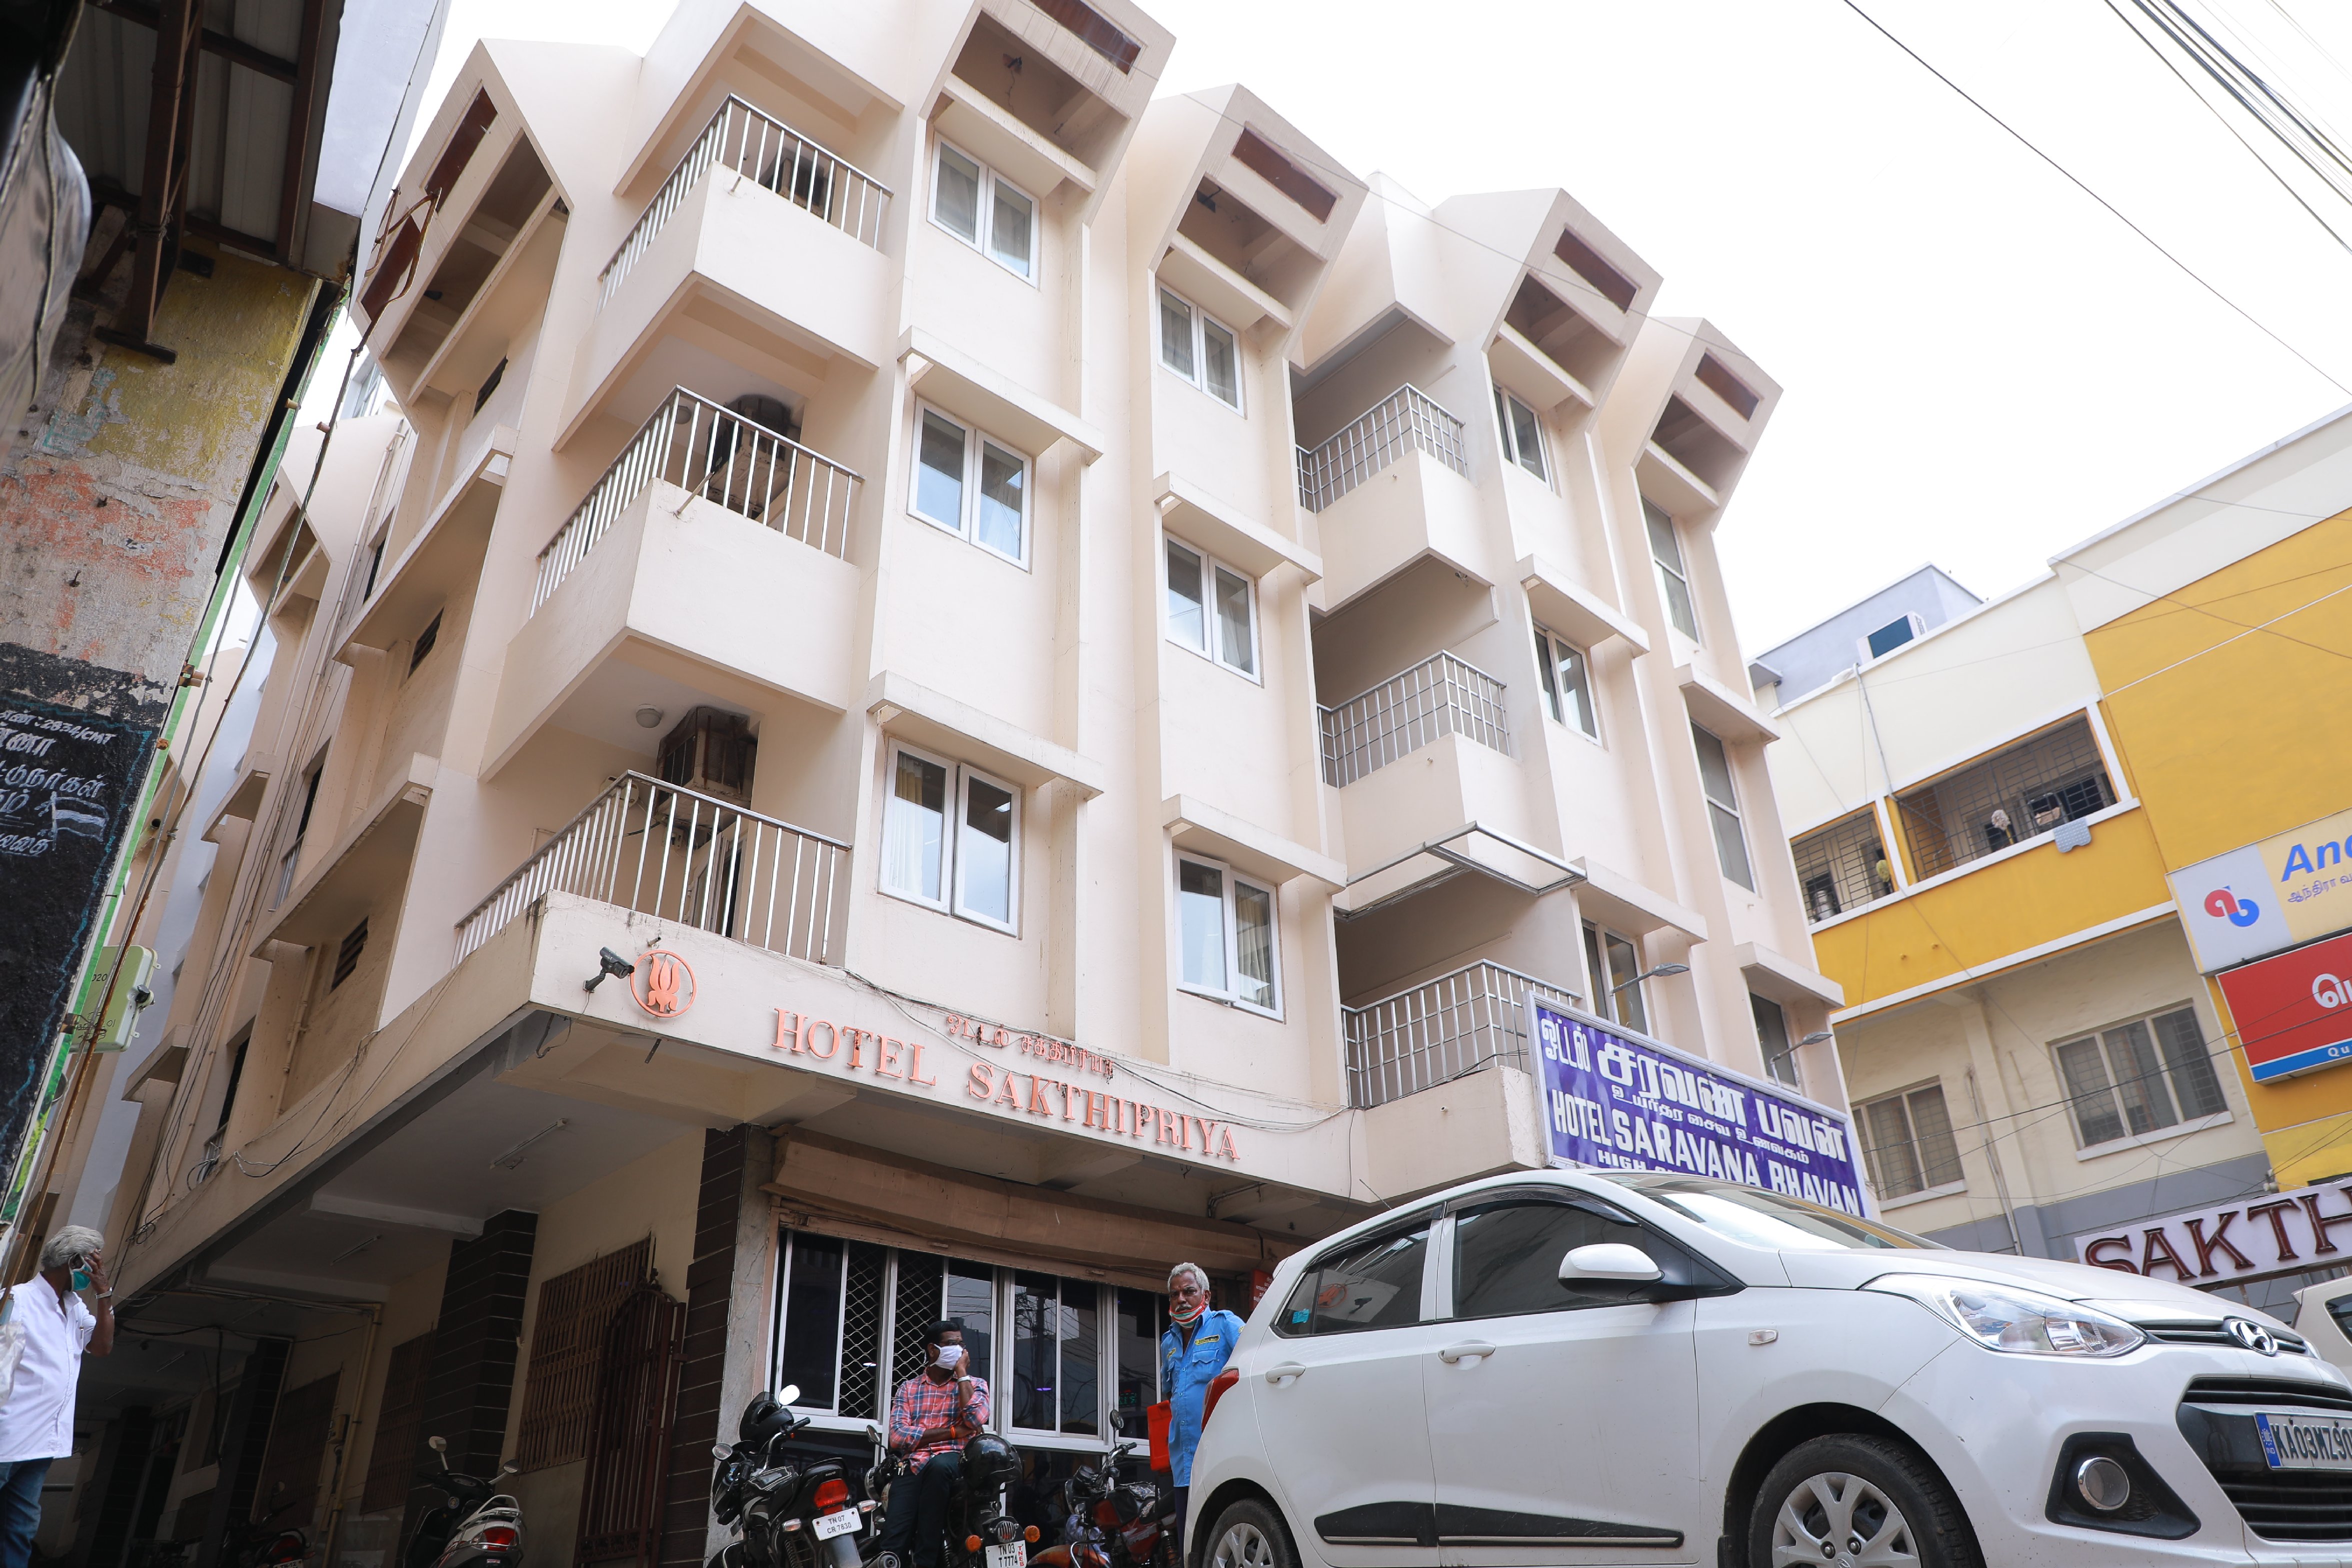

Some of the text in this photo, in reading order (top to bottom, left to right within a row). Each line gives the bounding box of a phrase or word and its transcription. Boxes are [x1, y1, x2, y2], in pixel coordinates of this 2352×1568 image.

[2287, 878, 2336, 902] ஆந்திரா
[2327, 1045, 2352, 1057] Qu
[772, 1008, 1241, 1160] HOTEL SAKTHIPRIYA
[1611, 1084, 1809, 1164] உயர்தர சைவ உணவகம்
[1755, 1098, 1847, 1162] பவன்
[1552, 1088, 1861, 1216] HOTEL SARAVANA BHAVAN
[1597, 1149, 1647, 1170] HIGH
[2269, 1423, 2352, 1460] KA03MZ90
[837, 1522, 852, 1531] 7830
[998, 1543, 1015, 1556] TN 03
[1004, 1554, 1018, 1567] 7774
